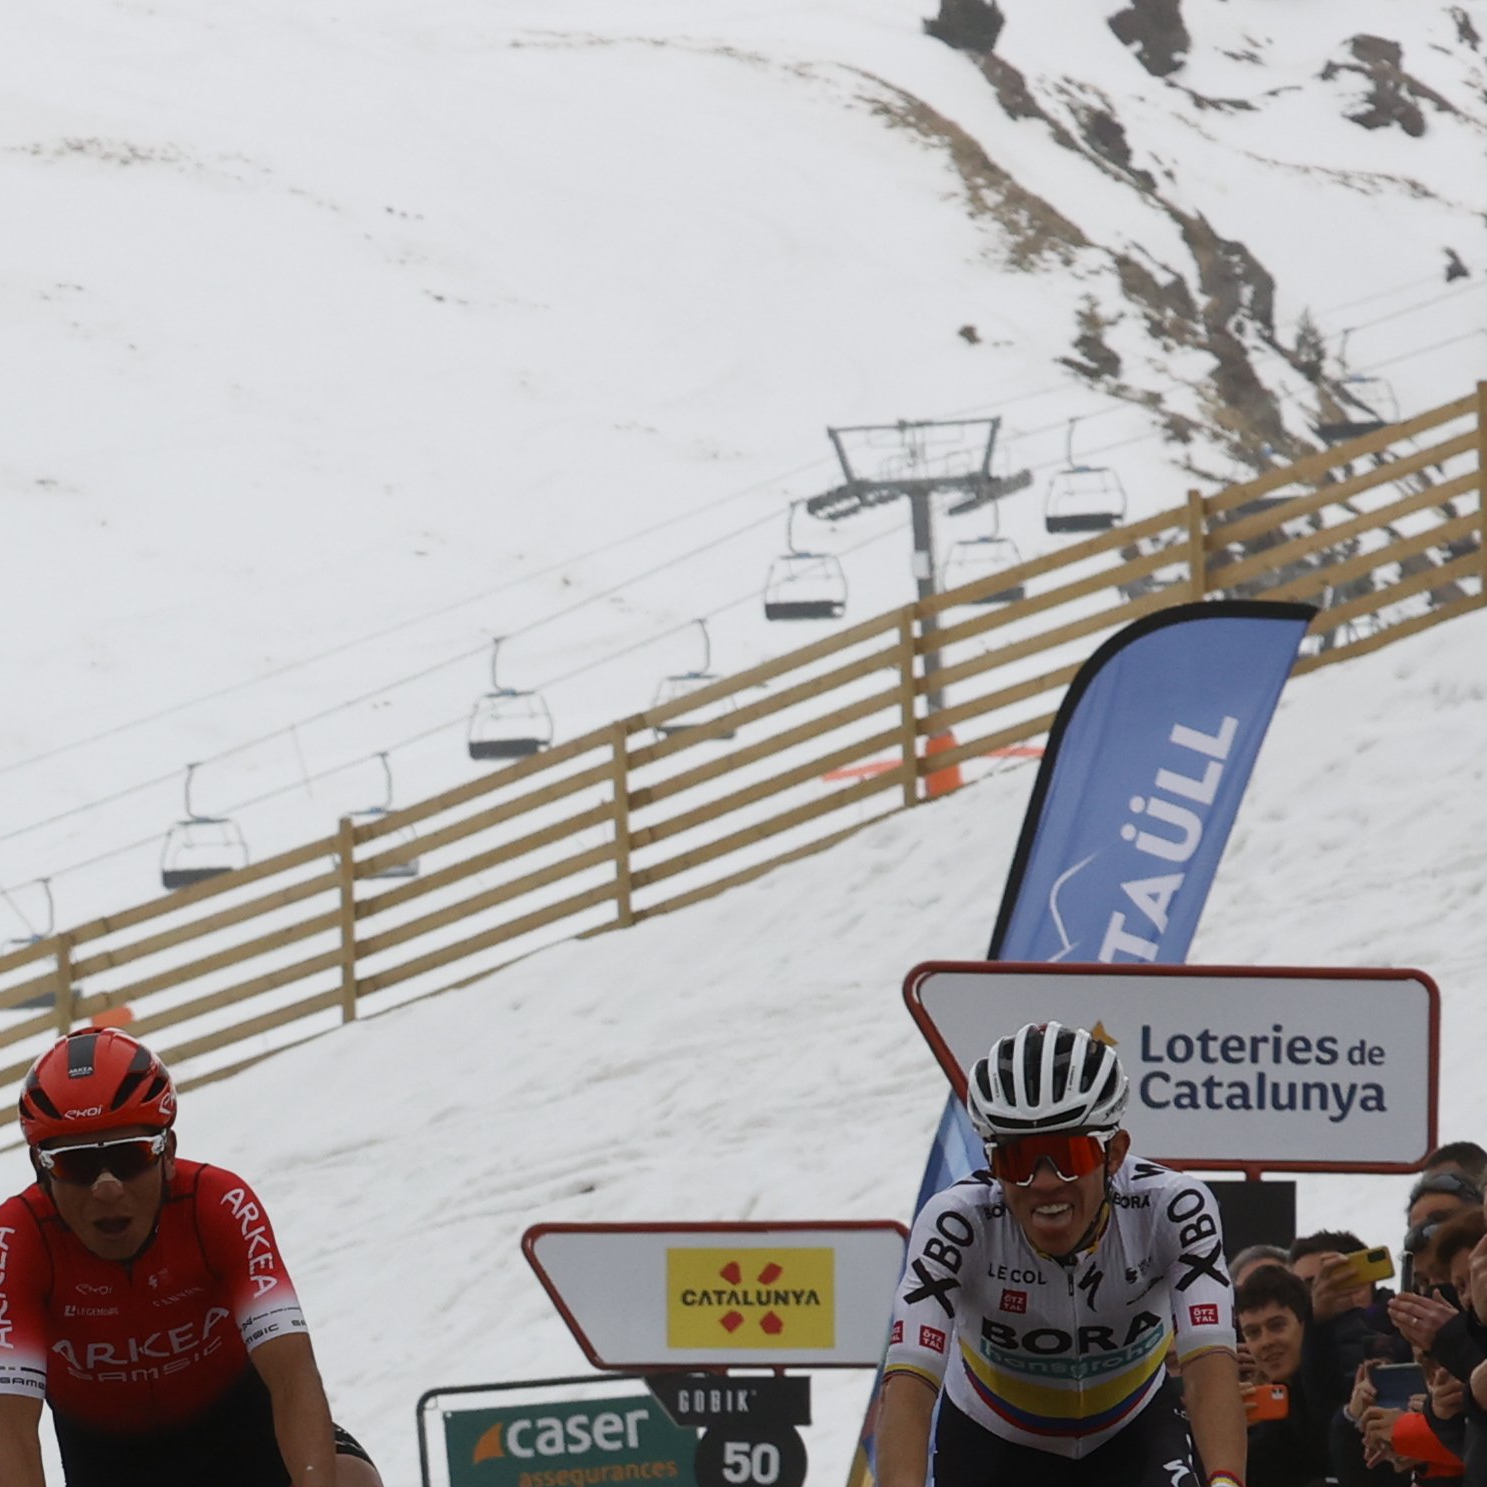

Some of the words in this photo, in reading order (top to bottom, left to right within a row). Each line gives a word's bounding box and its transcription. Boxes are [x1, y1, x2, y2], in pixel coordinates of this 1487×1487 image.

[1097, 713, 1240, 963] TAÜLL
[1140, 1024, 1338, 1065] Loteries
[1347, 1040, 1386, 1066] de
[1138, 1072, 1387, 1123] Catalunya
[220, 1188, 278, 1299] ARKEA
[988, 1263, 1006, 1280] LE
[1010, 1265, 1047, 1285] COL
[680, 1288, 821, 1308] CATALUNYA
[51, 1306, 230, 1371] ARKEA
[982, 1310, 1162, 1355] BORA
[506, 1409, 650, 1459] caser
[721, 1441, 781, 1486] 50
